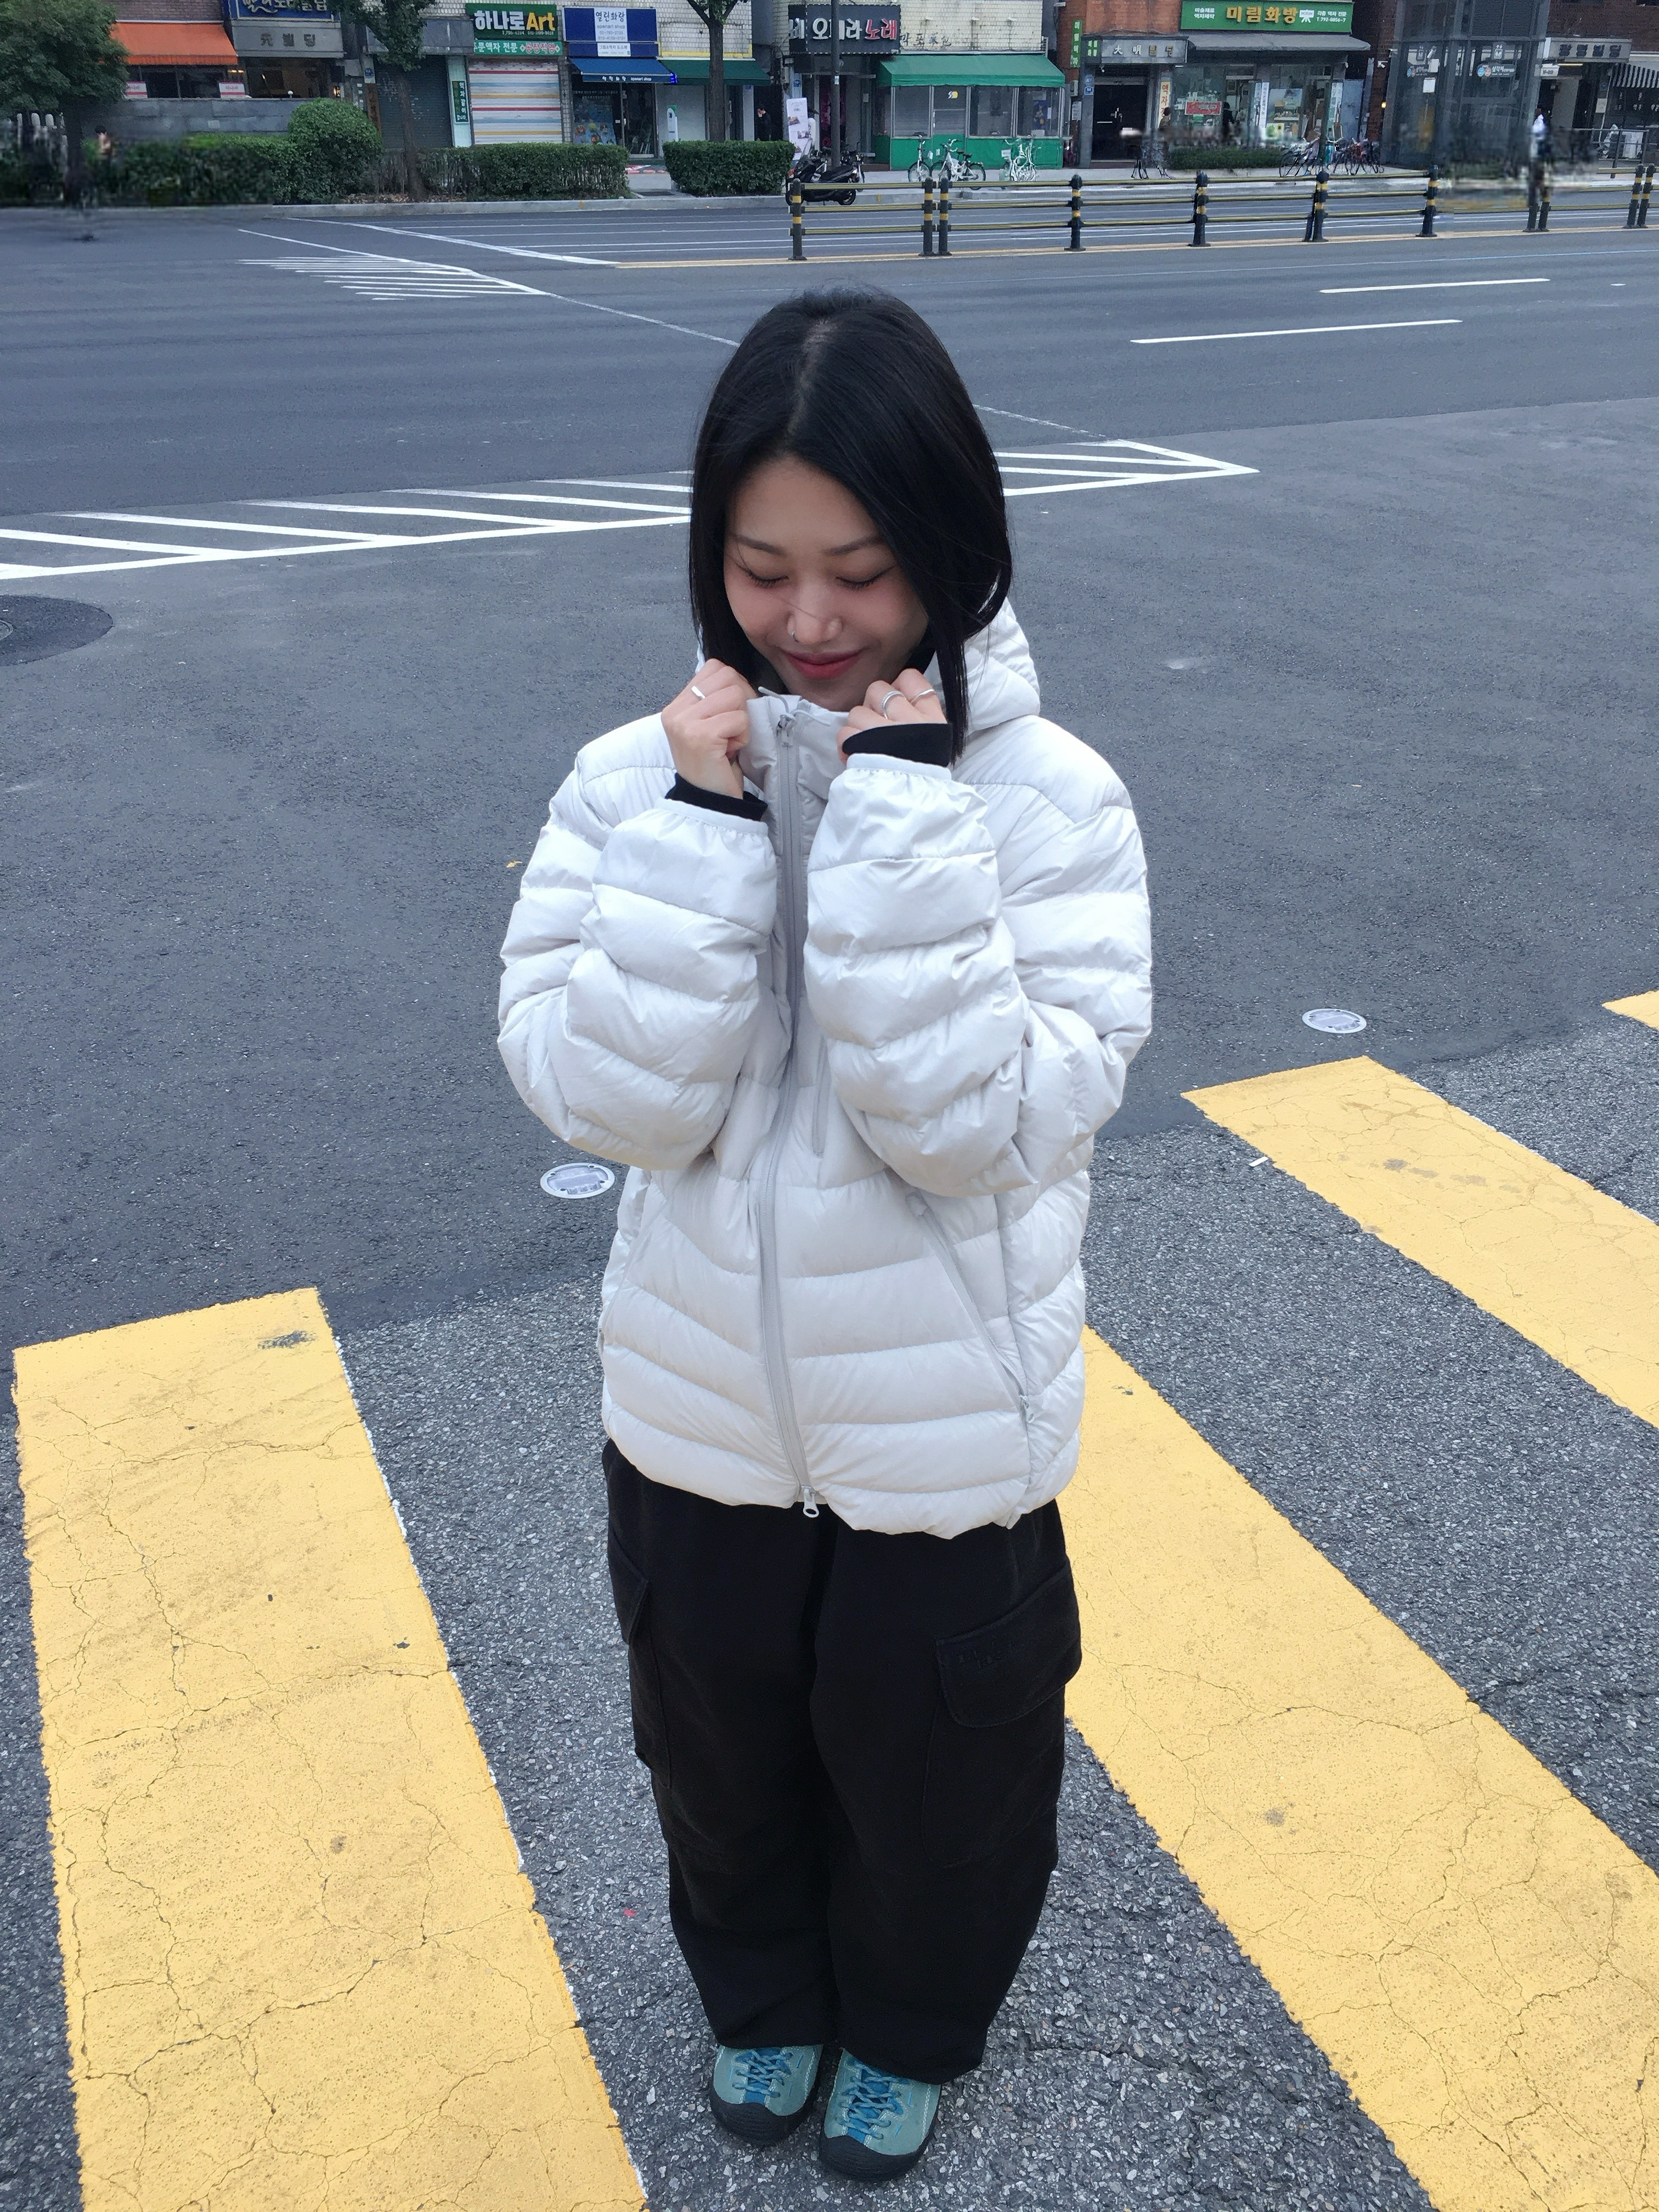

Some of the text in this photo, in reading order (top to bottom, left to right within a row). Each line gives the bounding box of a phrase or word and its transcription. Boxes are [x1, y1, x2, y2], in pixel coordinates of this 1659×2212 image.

[596, 12, 625, 22] 열린화랑
[1226, 6, 1298, 24] 미림화방
[864, 18, 898, 40] 노래
[503, 42, 518, 53] 전문
[524, 42, 556, 54] 공장직영
